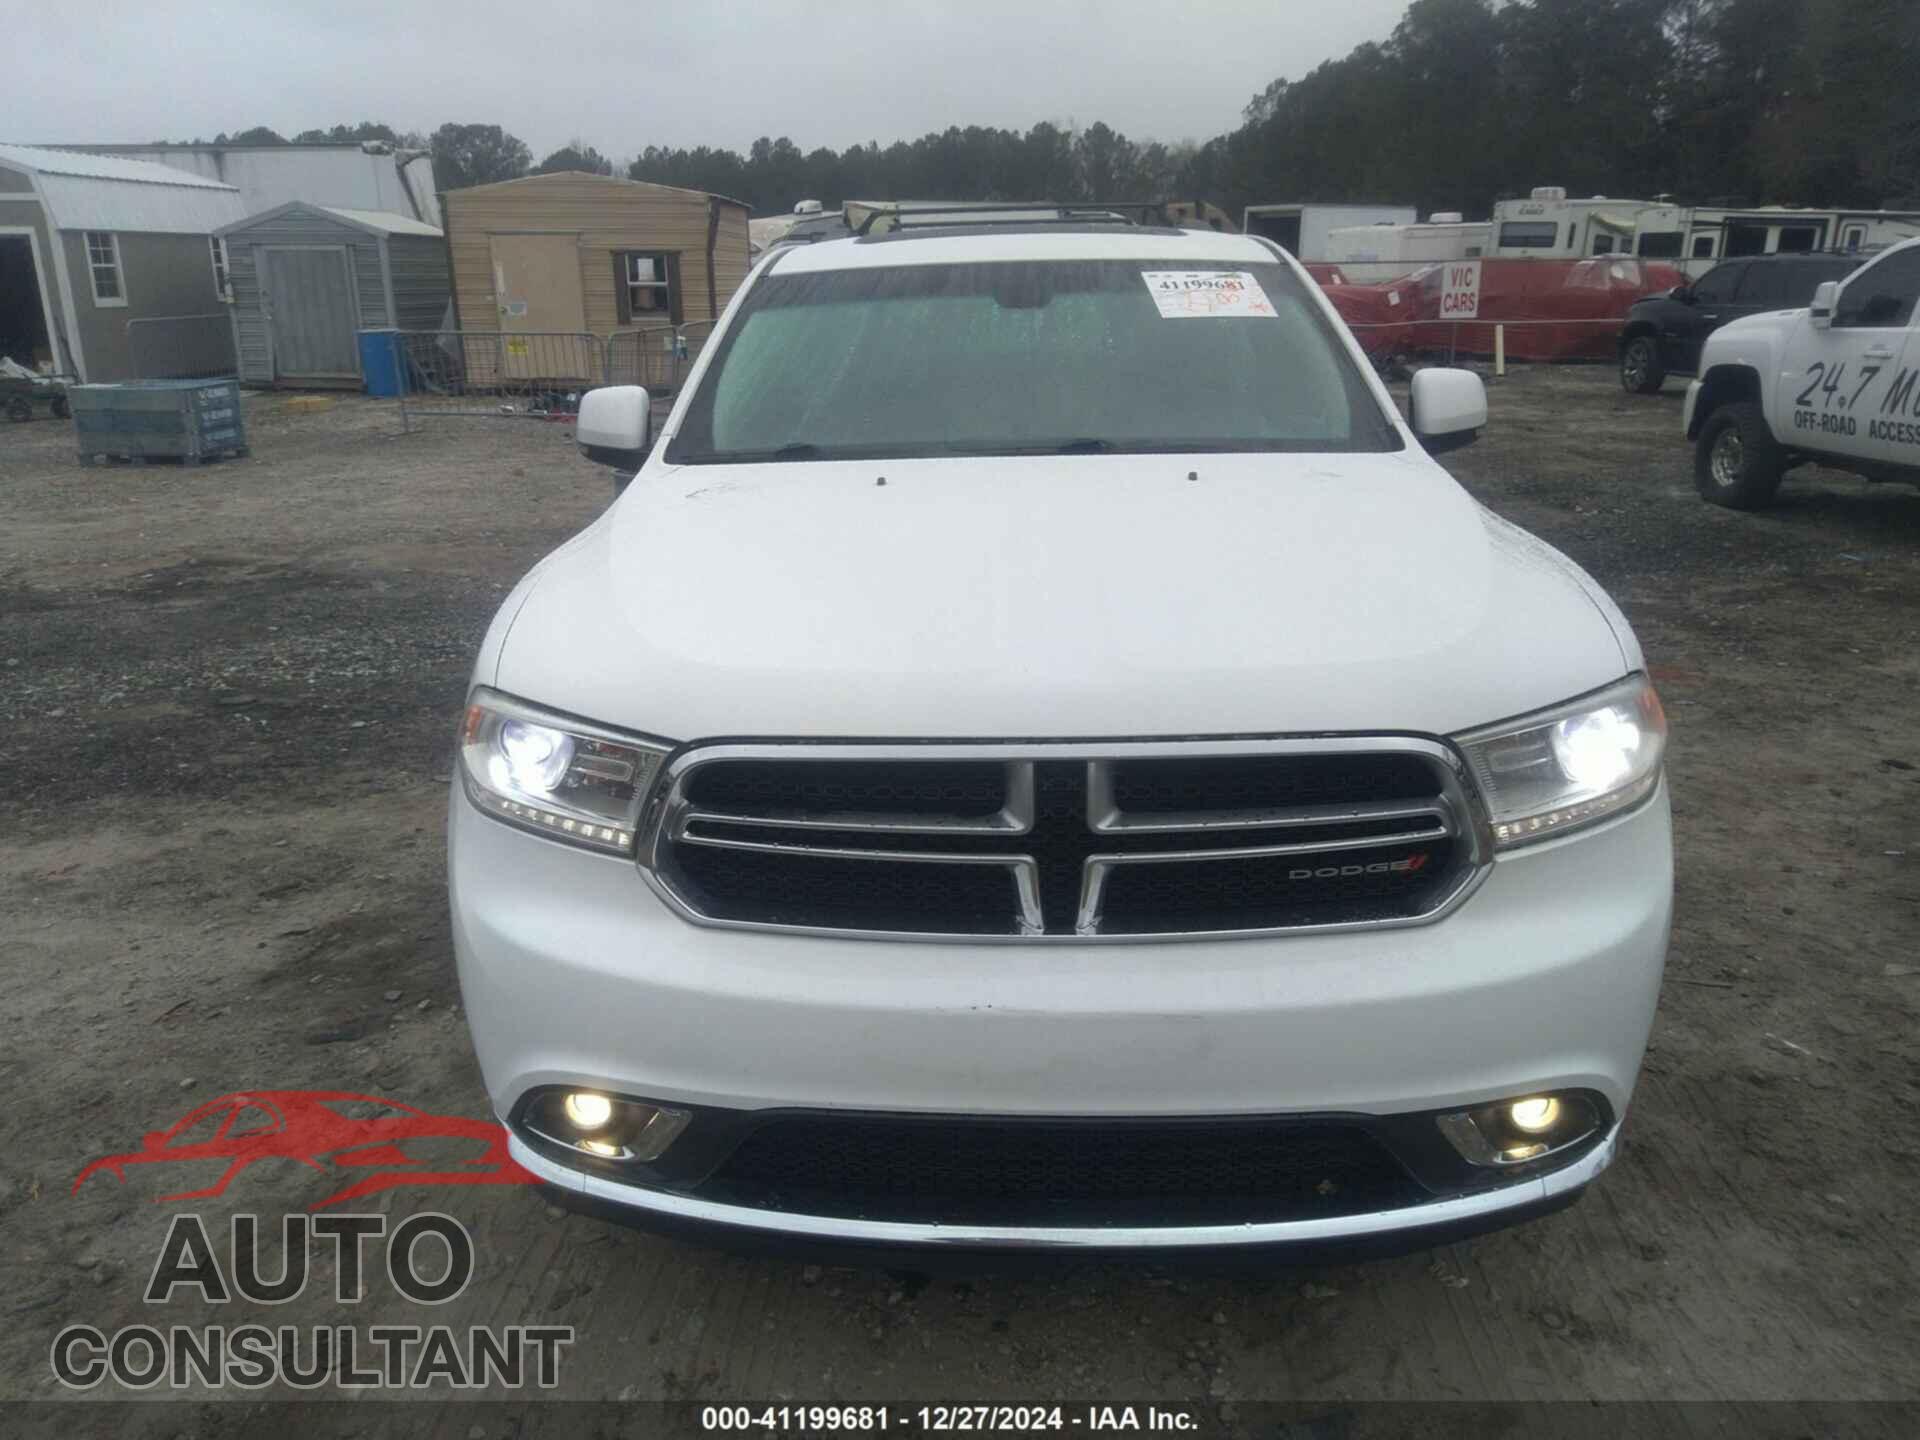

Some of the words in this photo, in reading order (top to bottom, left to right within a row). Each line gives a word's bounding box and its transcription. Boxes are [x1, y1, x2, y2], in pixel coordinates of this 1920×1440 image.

[1451, 266, 1473, 288] VIC
[1444, 292, 1475, 313] CARS
[1795, 361, 1881, 411] 24.7
[1794, 410, 1856, 436] OFF-ROAD
[1288, 858, 1412, 880] DODGE
